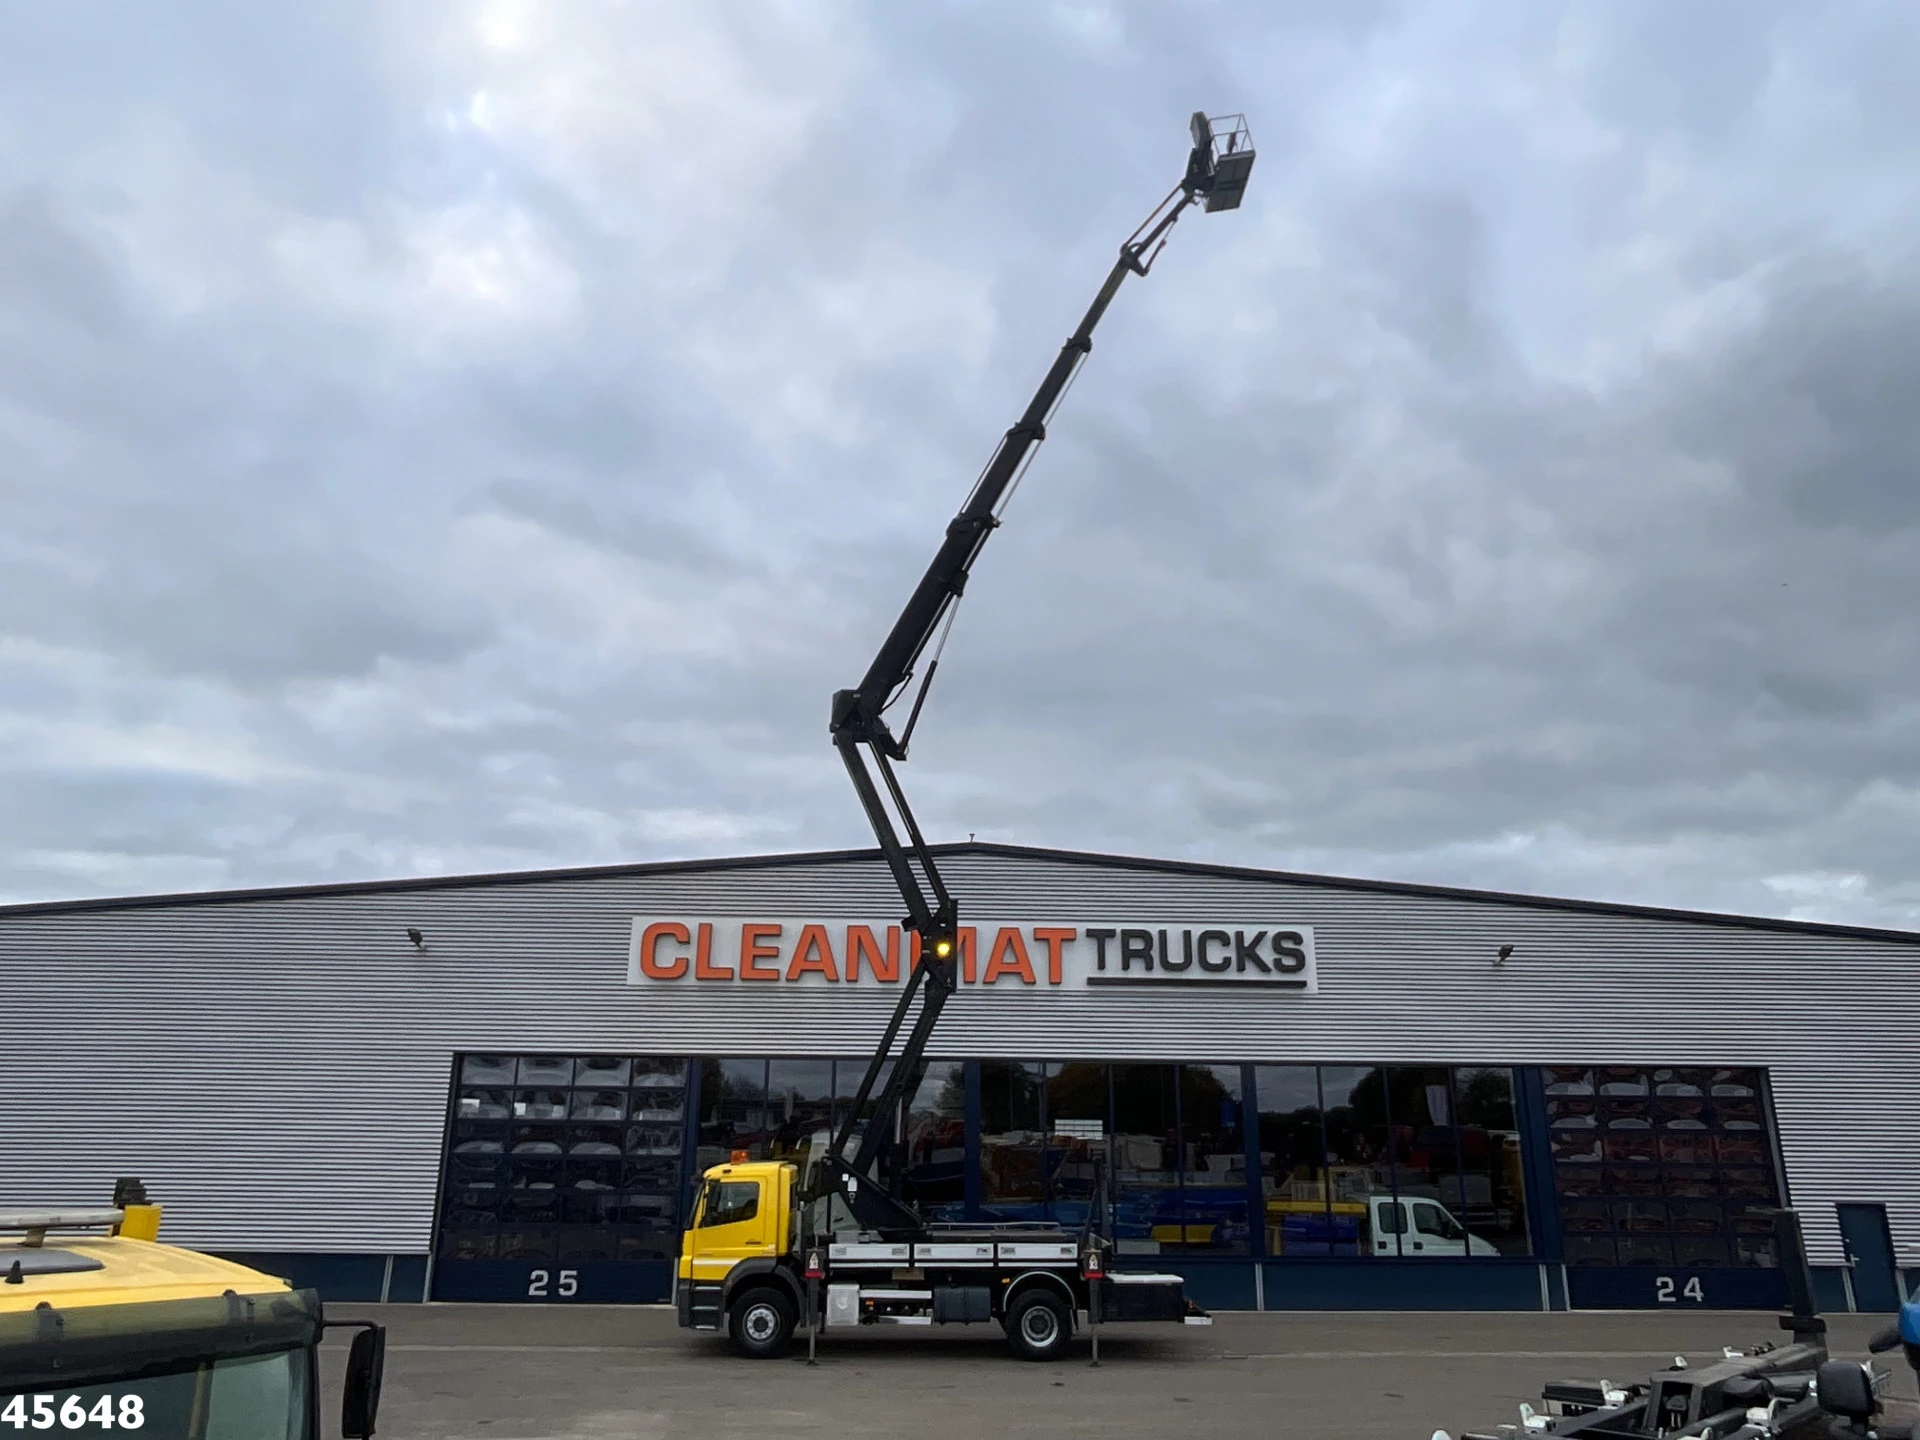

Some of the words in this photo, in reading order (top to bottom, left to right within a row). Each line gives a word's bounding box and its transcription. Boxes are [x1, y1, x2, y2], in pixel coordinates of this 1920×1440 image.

[1086, 928, 1306, 973] TRUCKS
[528, 1270, 578, 1296] 25
[1656, 1276, 1704, 1302] 24
